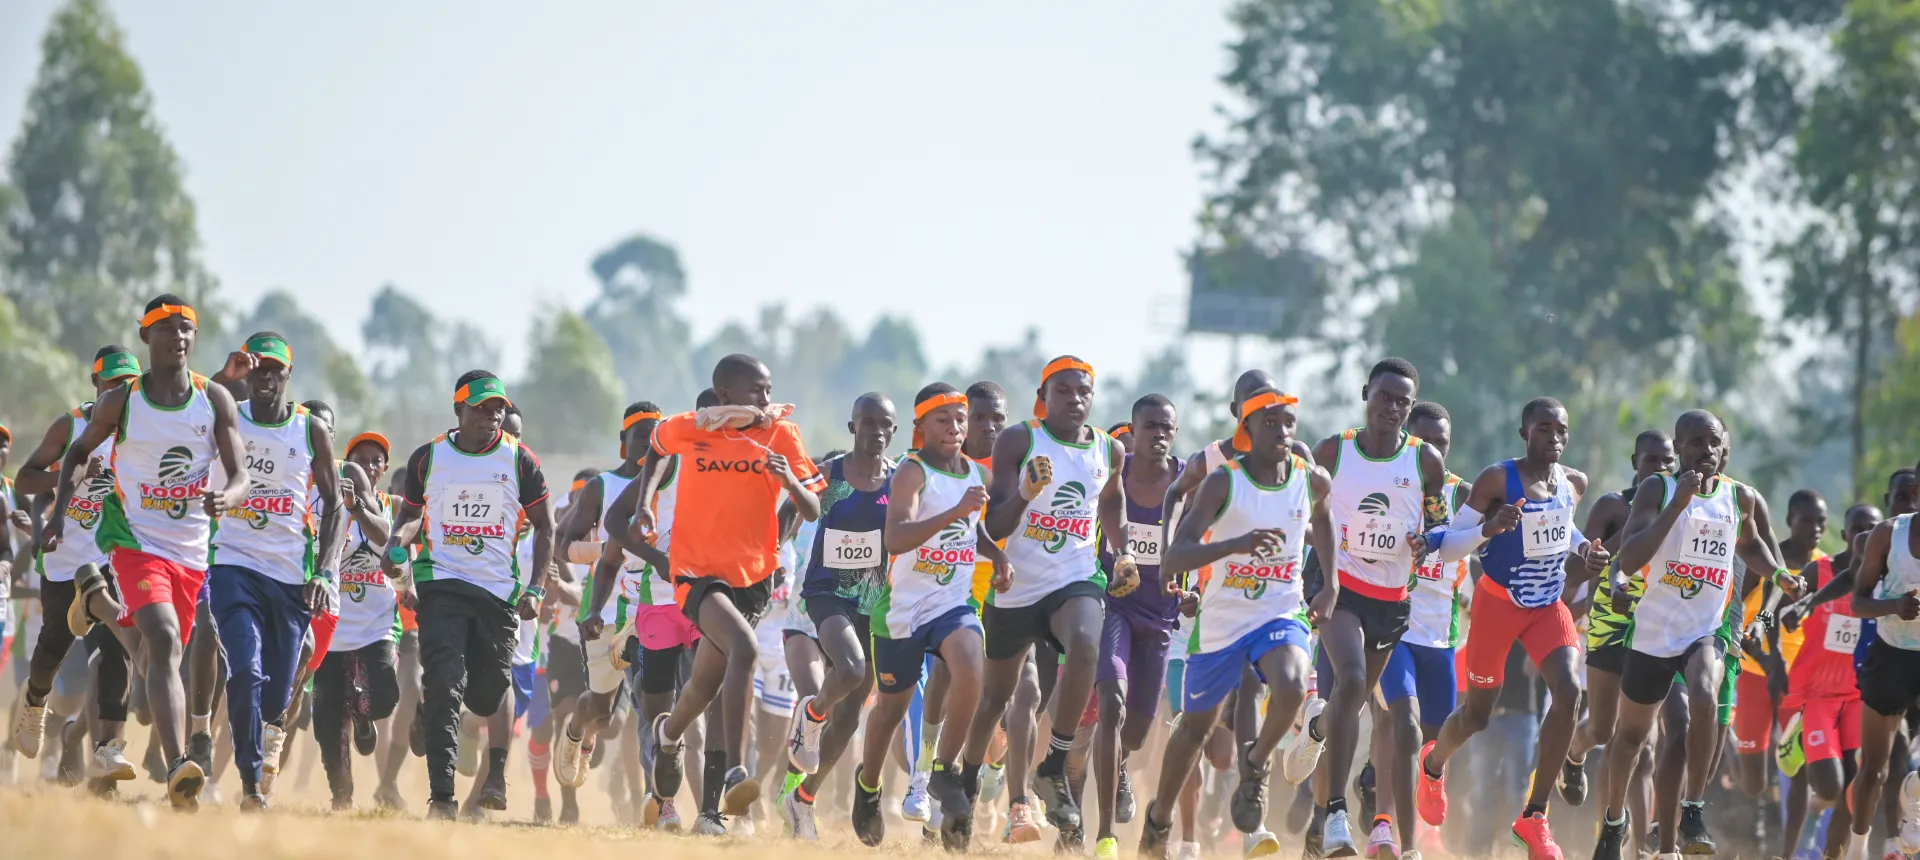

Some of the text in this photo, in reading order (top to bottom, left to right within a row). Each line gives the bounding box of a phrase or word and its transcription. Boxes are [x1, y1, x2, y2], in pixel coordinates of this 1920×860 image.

[168, 472, 197, 484] OLYMPIC
[141, 498, 176, 511] RUN
[452, 503, 491, 518] 1127
[227, 508, 257, 520] RUN
[441, 520, 504, 537] TOOKE
[1029, 511, 1091, 537] TOOKE
[443, 536, 473, 546] RUN
[1023, 526, 1057, 541] RUN
[1358, 531, 1396, 549] 1100
[1532, 525, 1566, 544] 1106
[835, 546, 873, 560] 1020
[1692, 537, 1727, 557] 1126
[912, 561, 949, 575] RUN
[1228, 562, 1295, 580] TOOKE
[1668, 562, 1729, 587] TOOKE
[1222, 577, 1258, 590] RUN
[1659, 573, 1695, 590] RUN
[1467, 668, 1494, 684] EOS
